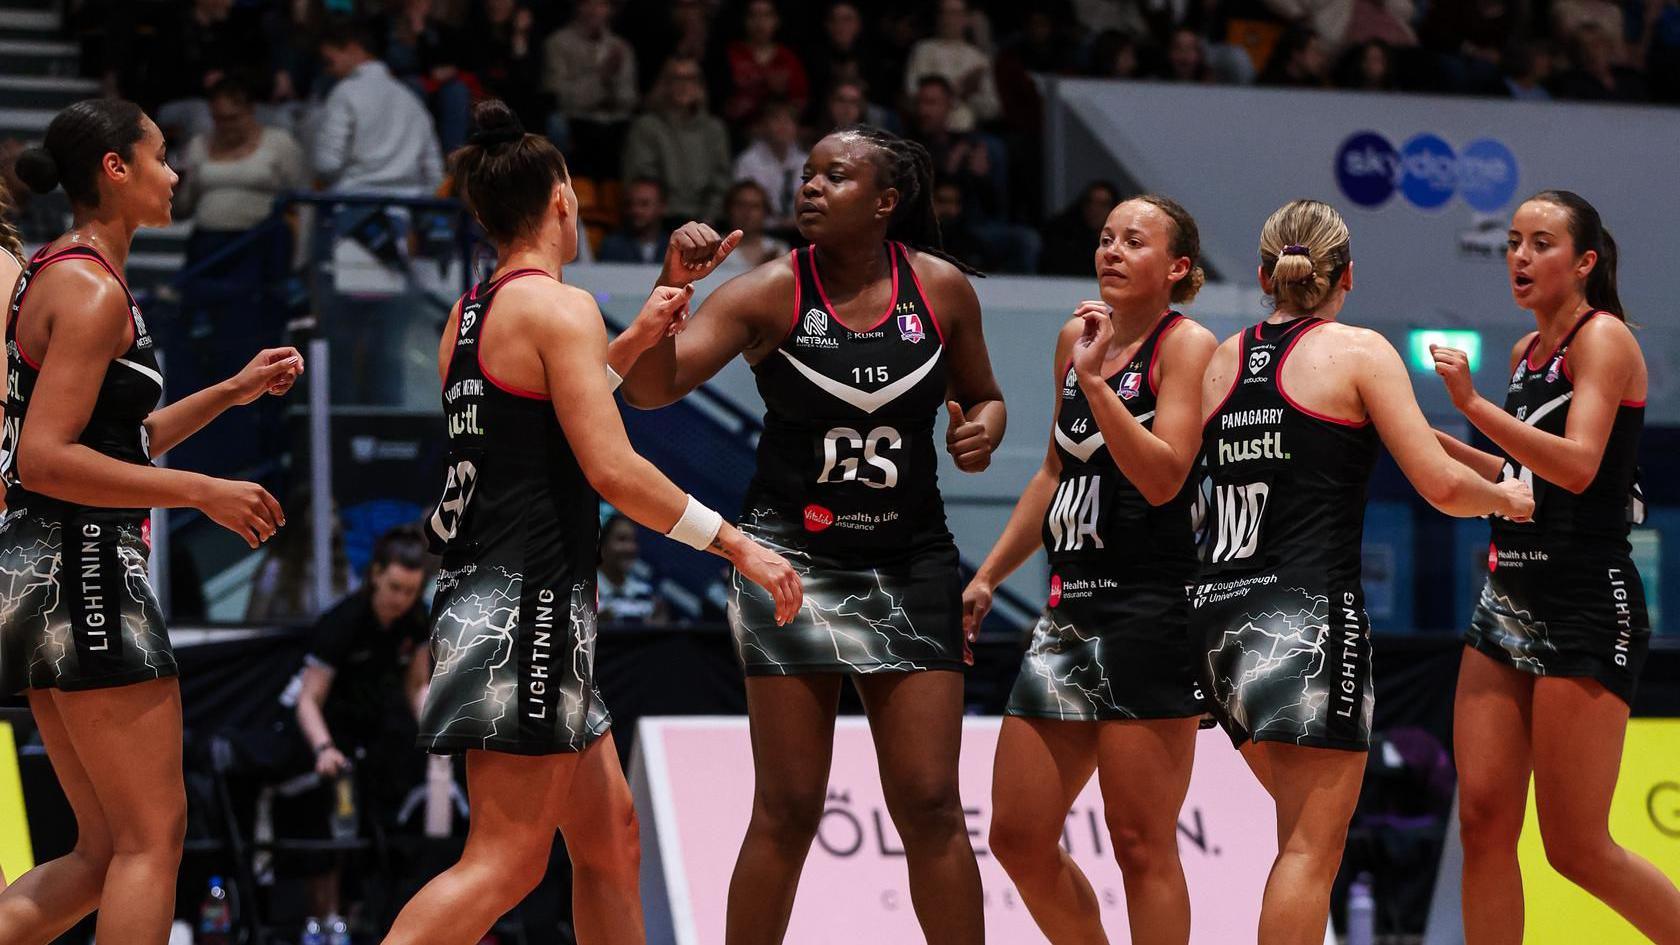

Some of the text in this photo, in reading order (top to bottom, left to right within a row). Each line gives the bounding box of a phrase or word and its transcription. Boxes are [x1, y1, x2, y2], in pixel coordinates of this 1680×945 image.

[796, 335, 839, 346] NETBALL
[854, 331, 884, 339] KUKRI
[851, 366, 889, 383] 115
[1070, 417, 1088, 434] 46
[1221, 408, 1284, 430] PANAGARRY
[816, 425, 902, 489] GS
[1218, 431, 1291, 466] hustl.
[837, 511, 899, 523] Health & Life
[1048, 475, 1105, 552] WA
[1212, 481, 1270, 564] WD
[835, 520, 875, 531] insurance
[1498, 550, 1520, 560] Health
[1521, 551, 1528, 560] &
[1529, 551, 1549, 561] Life
[81, 523, 108, 651] LIGHTNING
[1063, 579, 1089, 591] Health
[1090, 580, 1097, 588] &
[1098, 578, 1118, 588] Life
[1211, 574, 1278, 592] Loughborough
[1209, 586, 1251, 603] University
[1607, 568, 1632, 667] LIGHTING
[529, 588, 555, 719] LIGHTNING
[1336, 591, 1360, 718] LIGHTNING
